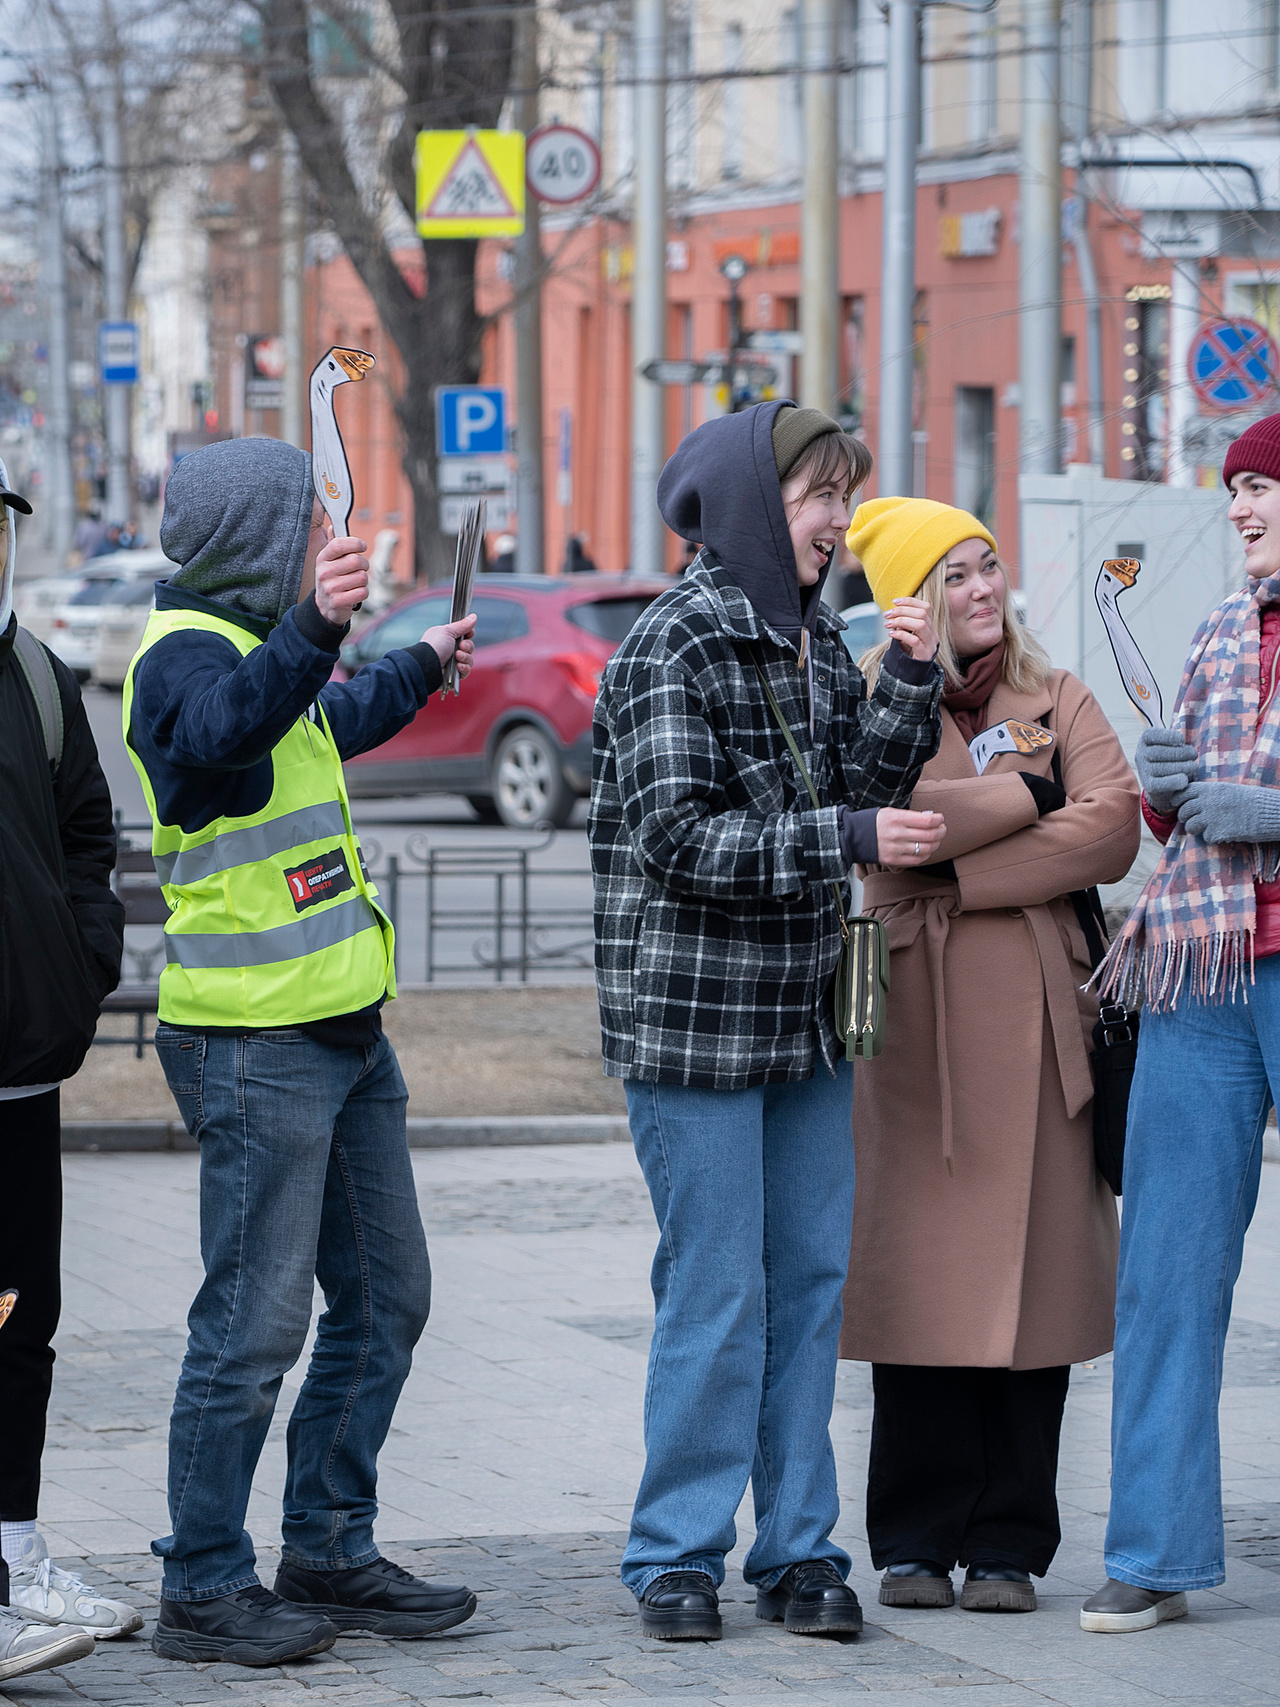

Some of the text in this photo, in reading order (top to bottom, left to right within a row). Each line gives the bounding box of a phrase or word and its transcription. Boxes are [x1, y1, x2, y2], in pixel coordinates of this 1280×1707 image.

[538, 148, 586, 179] 40
[456, 394, 497, 450] P
[305, 865, 323, 877] ЦЕНТР
[308, 863, 345, 886] ОПЕРАТИВНОЙ
[311, 879, 332, 894] ПЕЧАТИ
